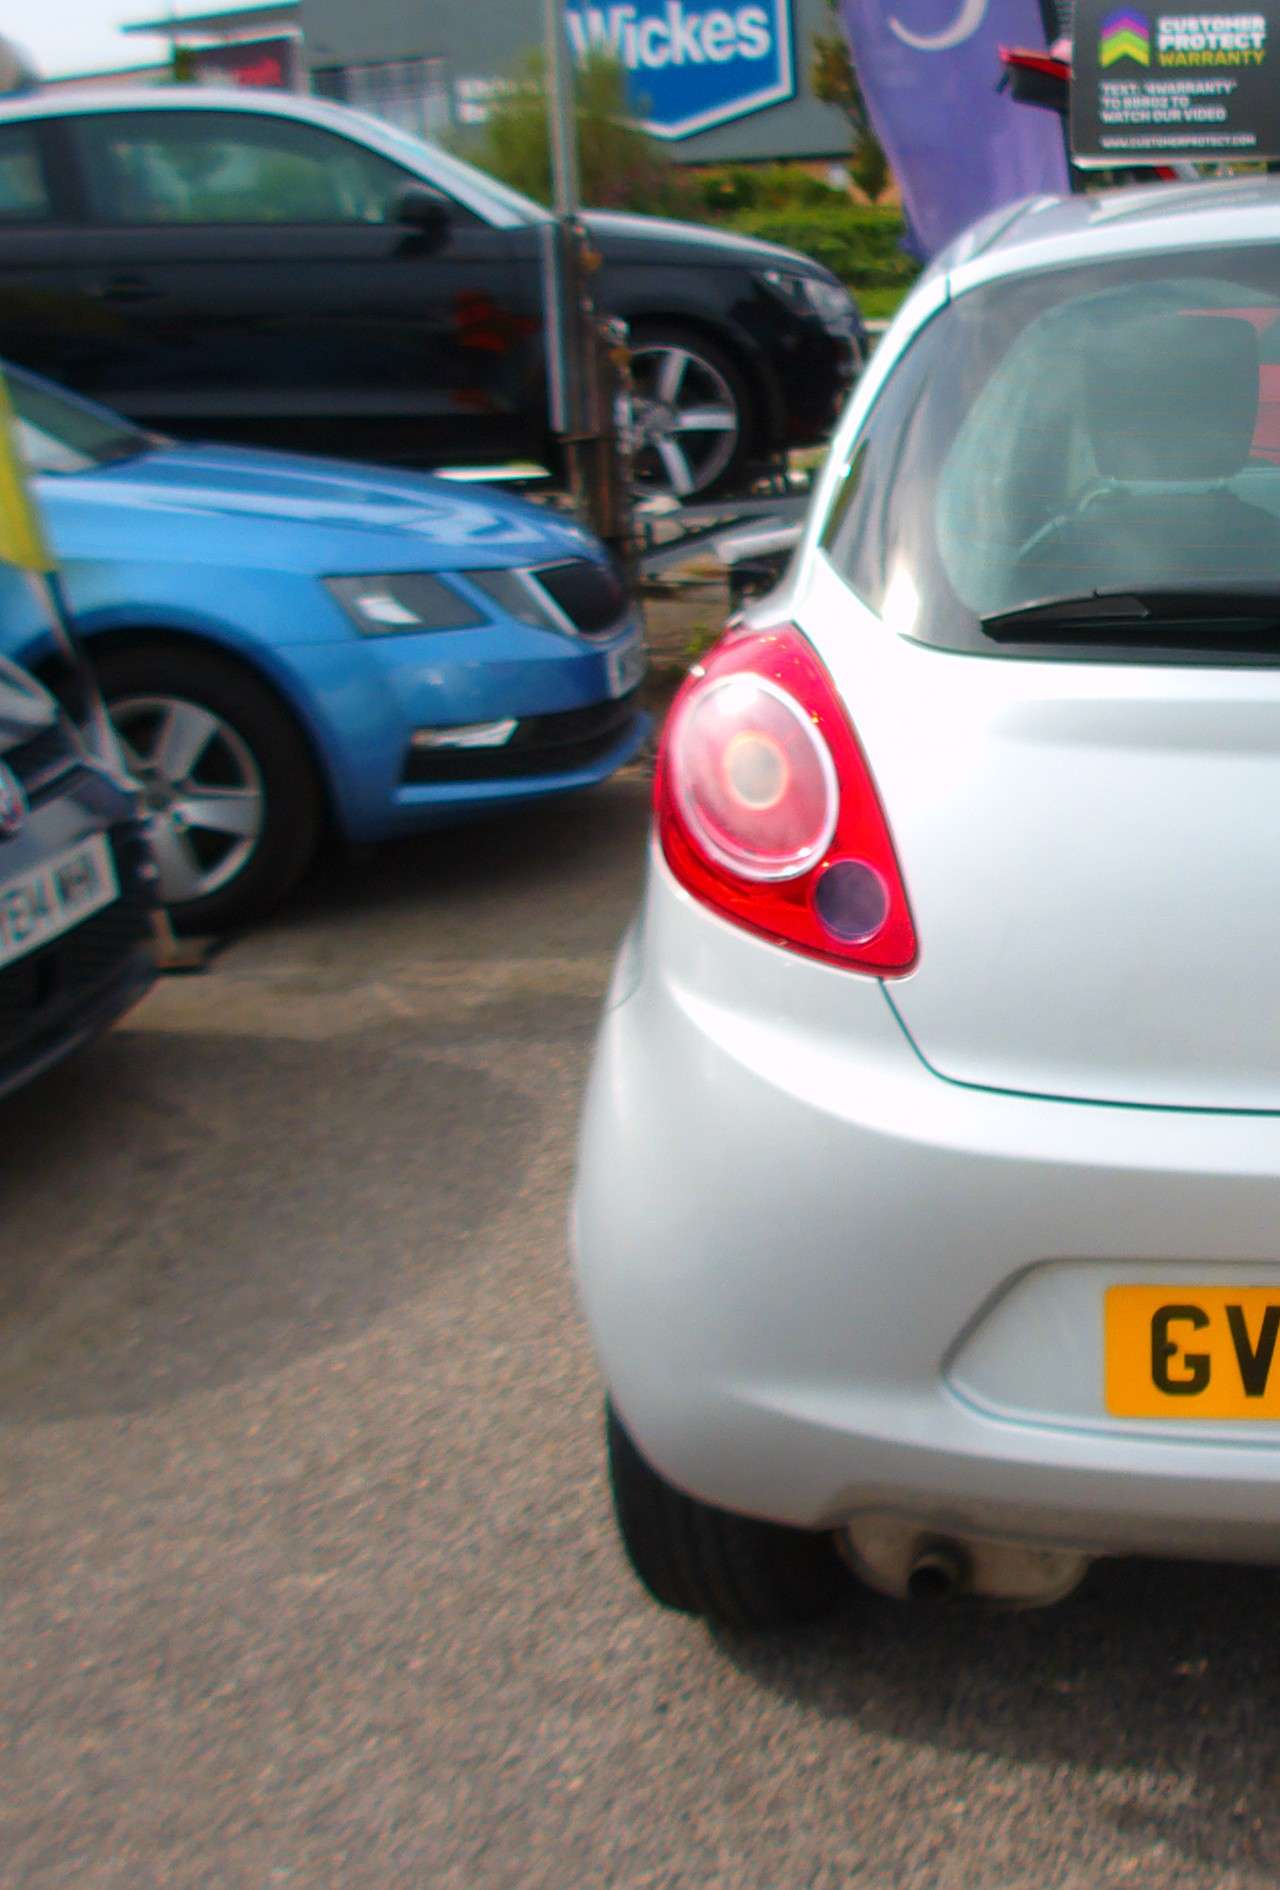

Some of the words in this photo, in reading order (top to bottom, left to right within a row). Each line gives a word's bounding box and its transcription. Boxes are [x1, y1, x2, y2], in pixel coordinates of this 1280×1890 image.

[1158, 15, 1266, 33] CUSTOMER
[566, 0, 771, 69] Wickes
[1158, 32, 1267, 50] PROTECT
[1158, 50, 1266, 66] WARRANTY
[1102, 97, 1121, 109] TO
[1171, 96, 1190, 109] TO
[1101, 110, 1151, 123] WATCH
[1152, 109, 1182, 122] OUR
[1184, 107, 1227, 122] VIDEO
